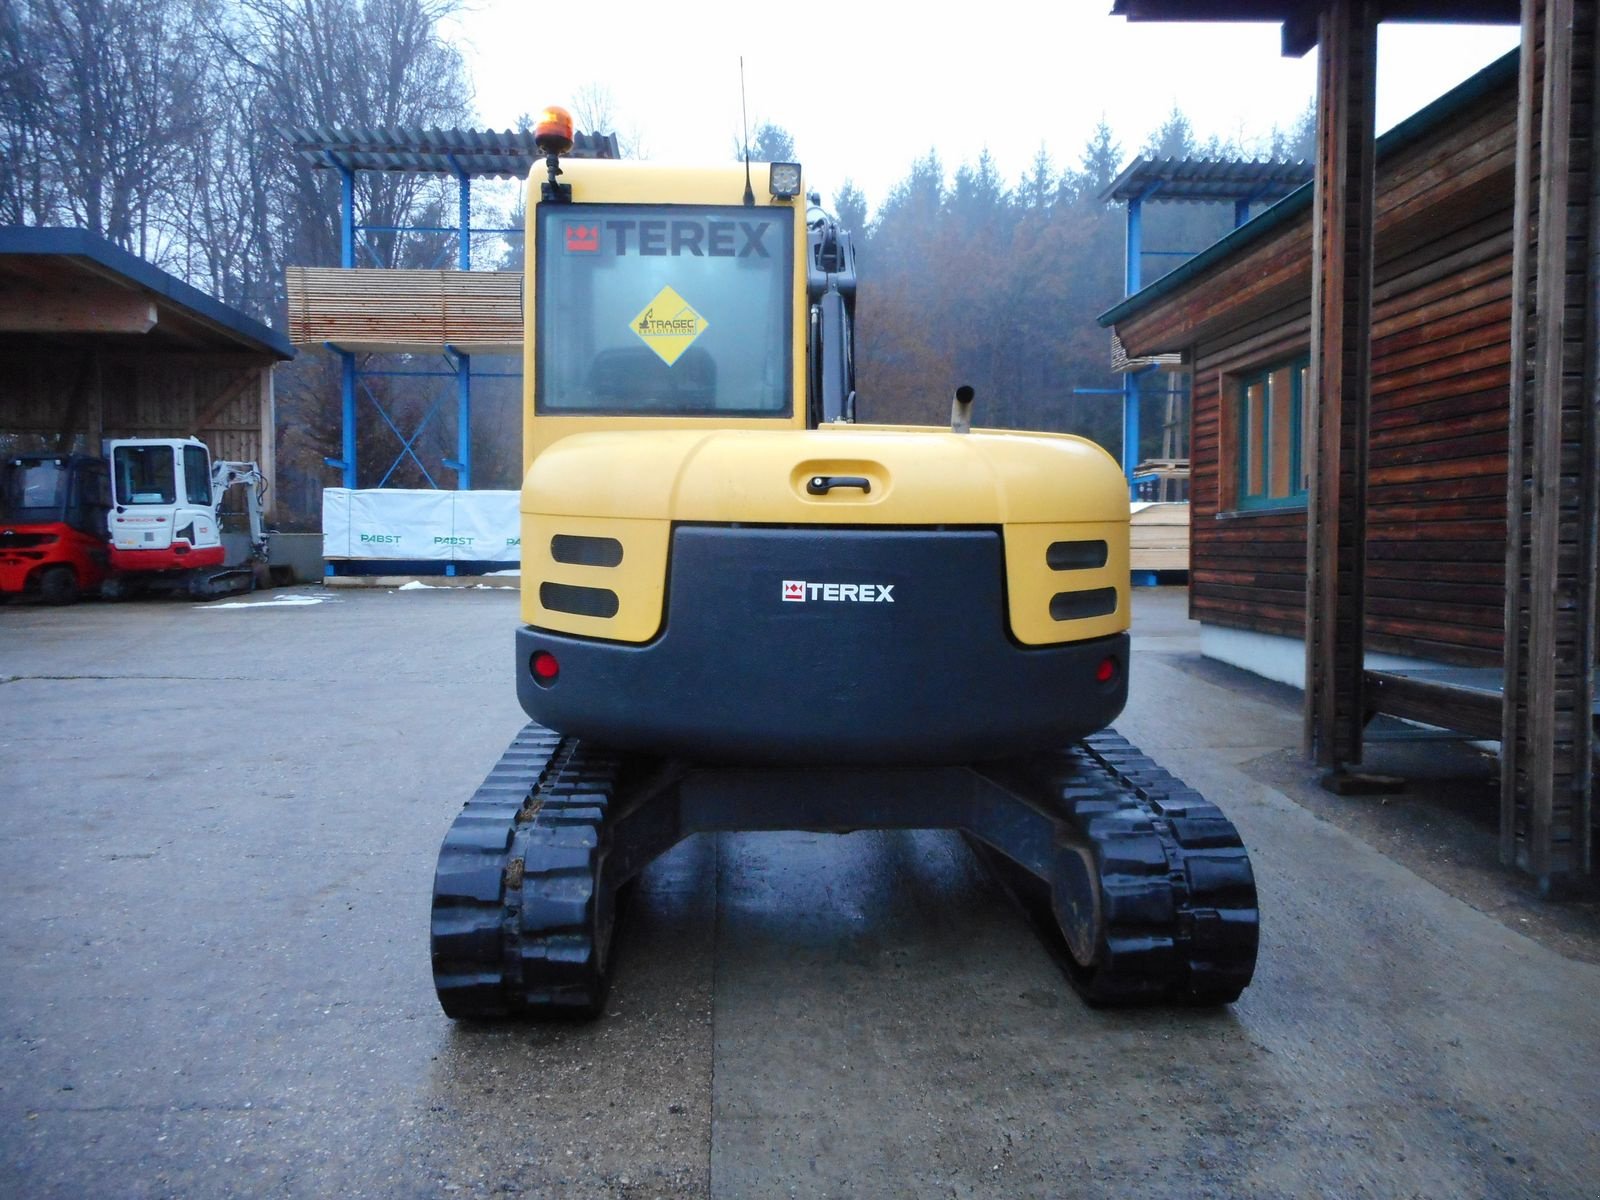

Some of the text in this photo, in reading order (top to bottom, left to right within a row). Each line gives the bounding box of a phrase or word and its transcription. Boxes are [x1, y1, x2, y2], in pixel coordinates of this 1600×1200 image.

[606, 220, 772, 258] TEREX
[649, 319, 694, 329] TRAGEC
[361, 534, 402, 544] PABST
[434, 536, 475, 545] PABST
[807, 582, 895, 602] TEREX
